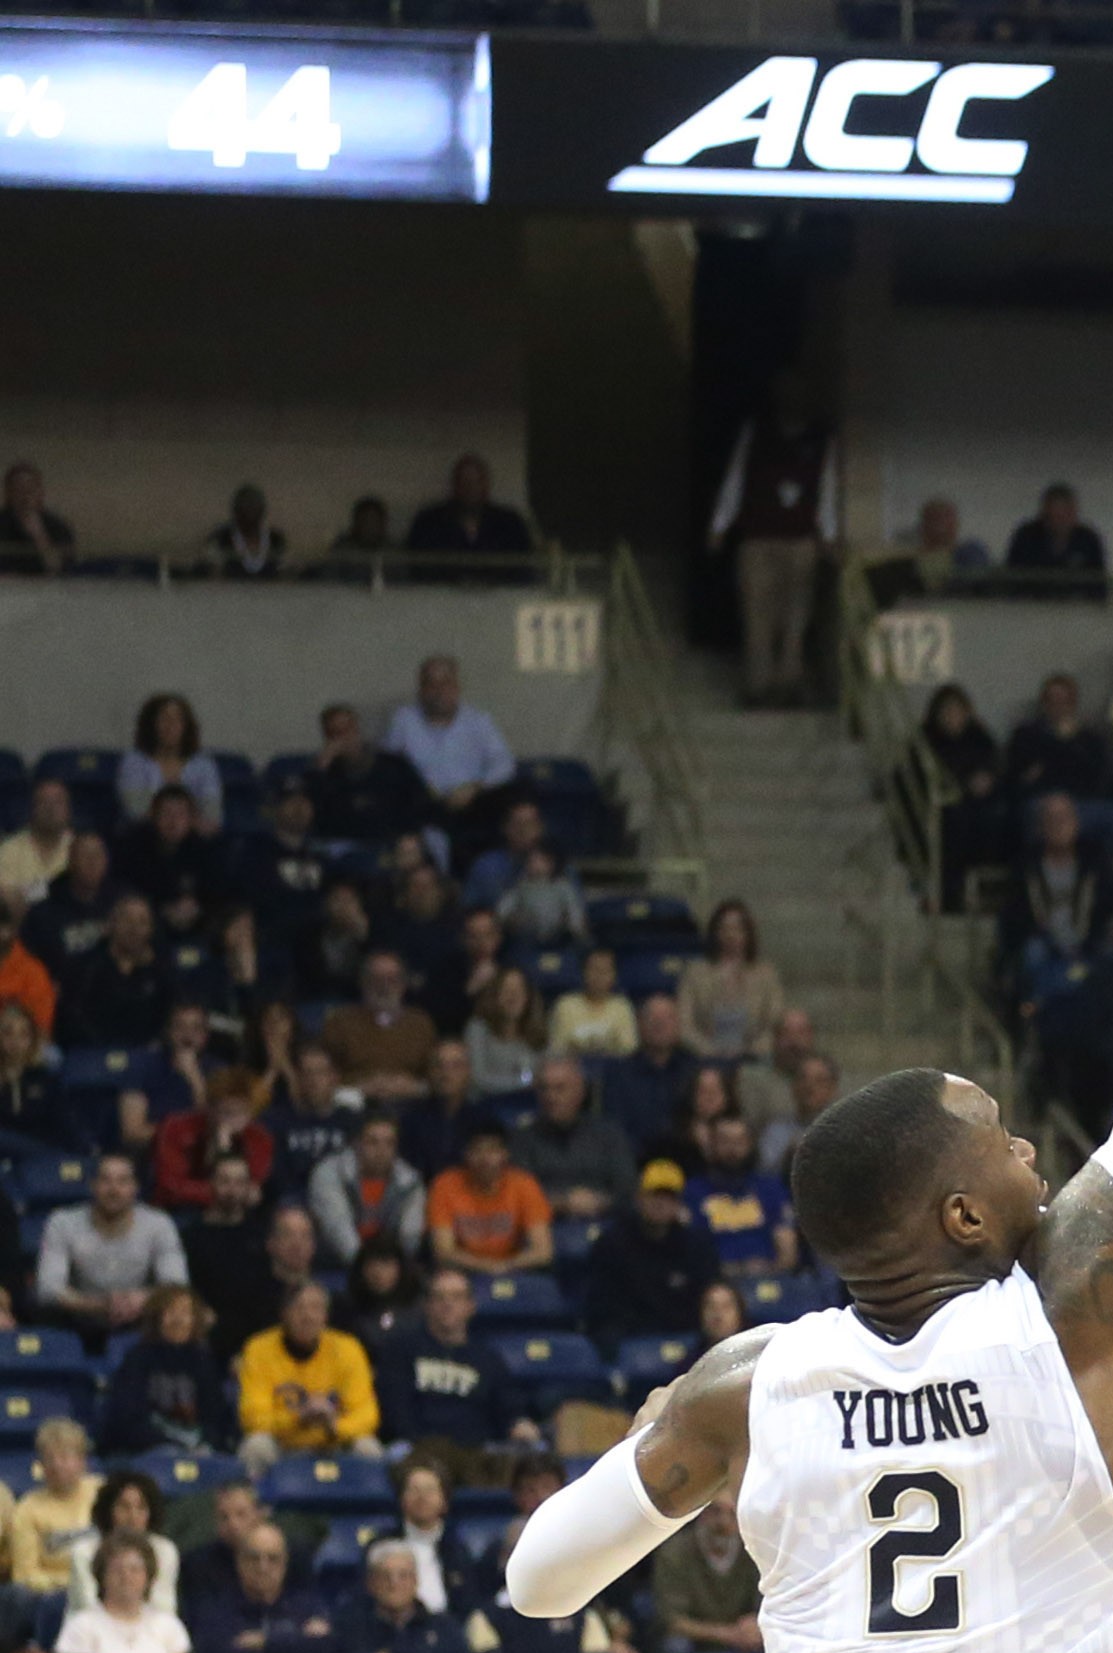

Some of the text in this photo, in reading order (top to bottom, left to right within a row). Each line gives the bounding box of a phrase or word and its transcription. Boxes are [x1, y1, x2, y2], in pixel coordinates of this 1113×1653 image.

[168, 62, 341, 170] 44
[643, 56, 1055, 176] ACC
[833, 1379, 989, 1449] YOUNG
[864, 1467, 965, 1636] 2
